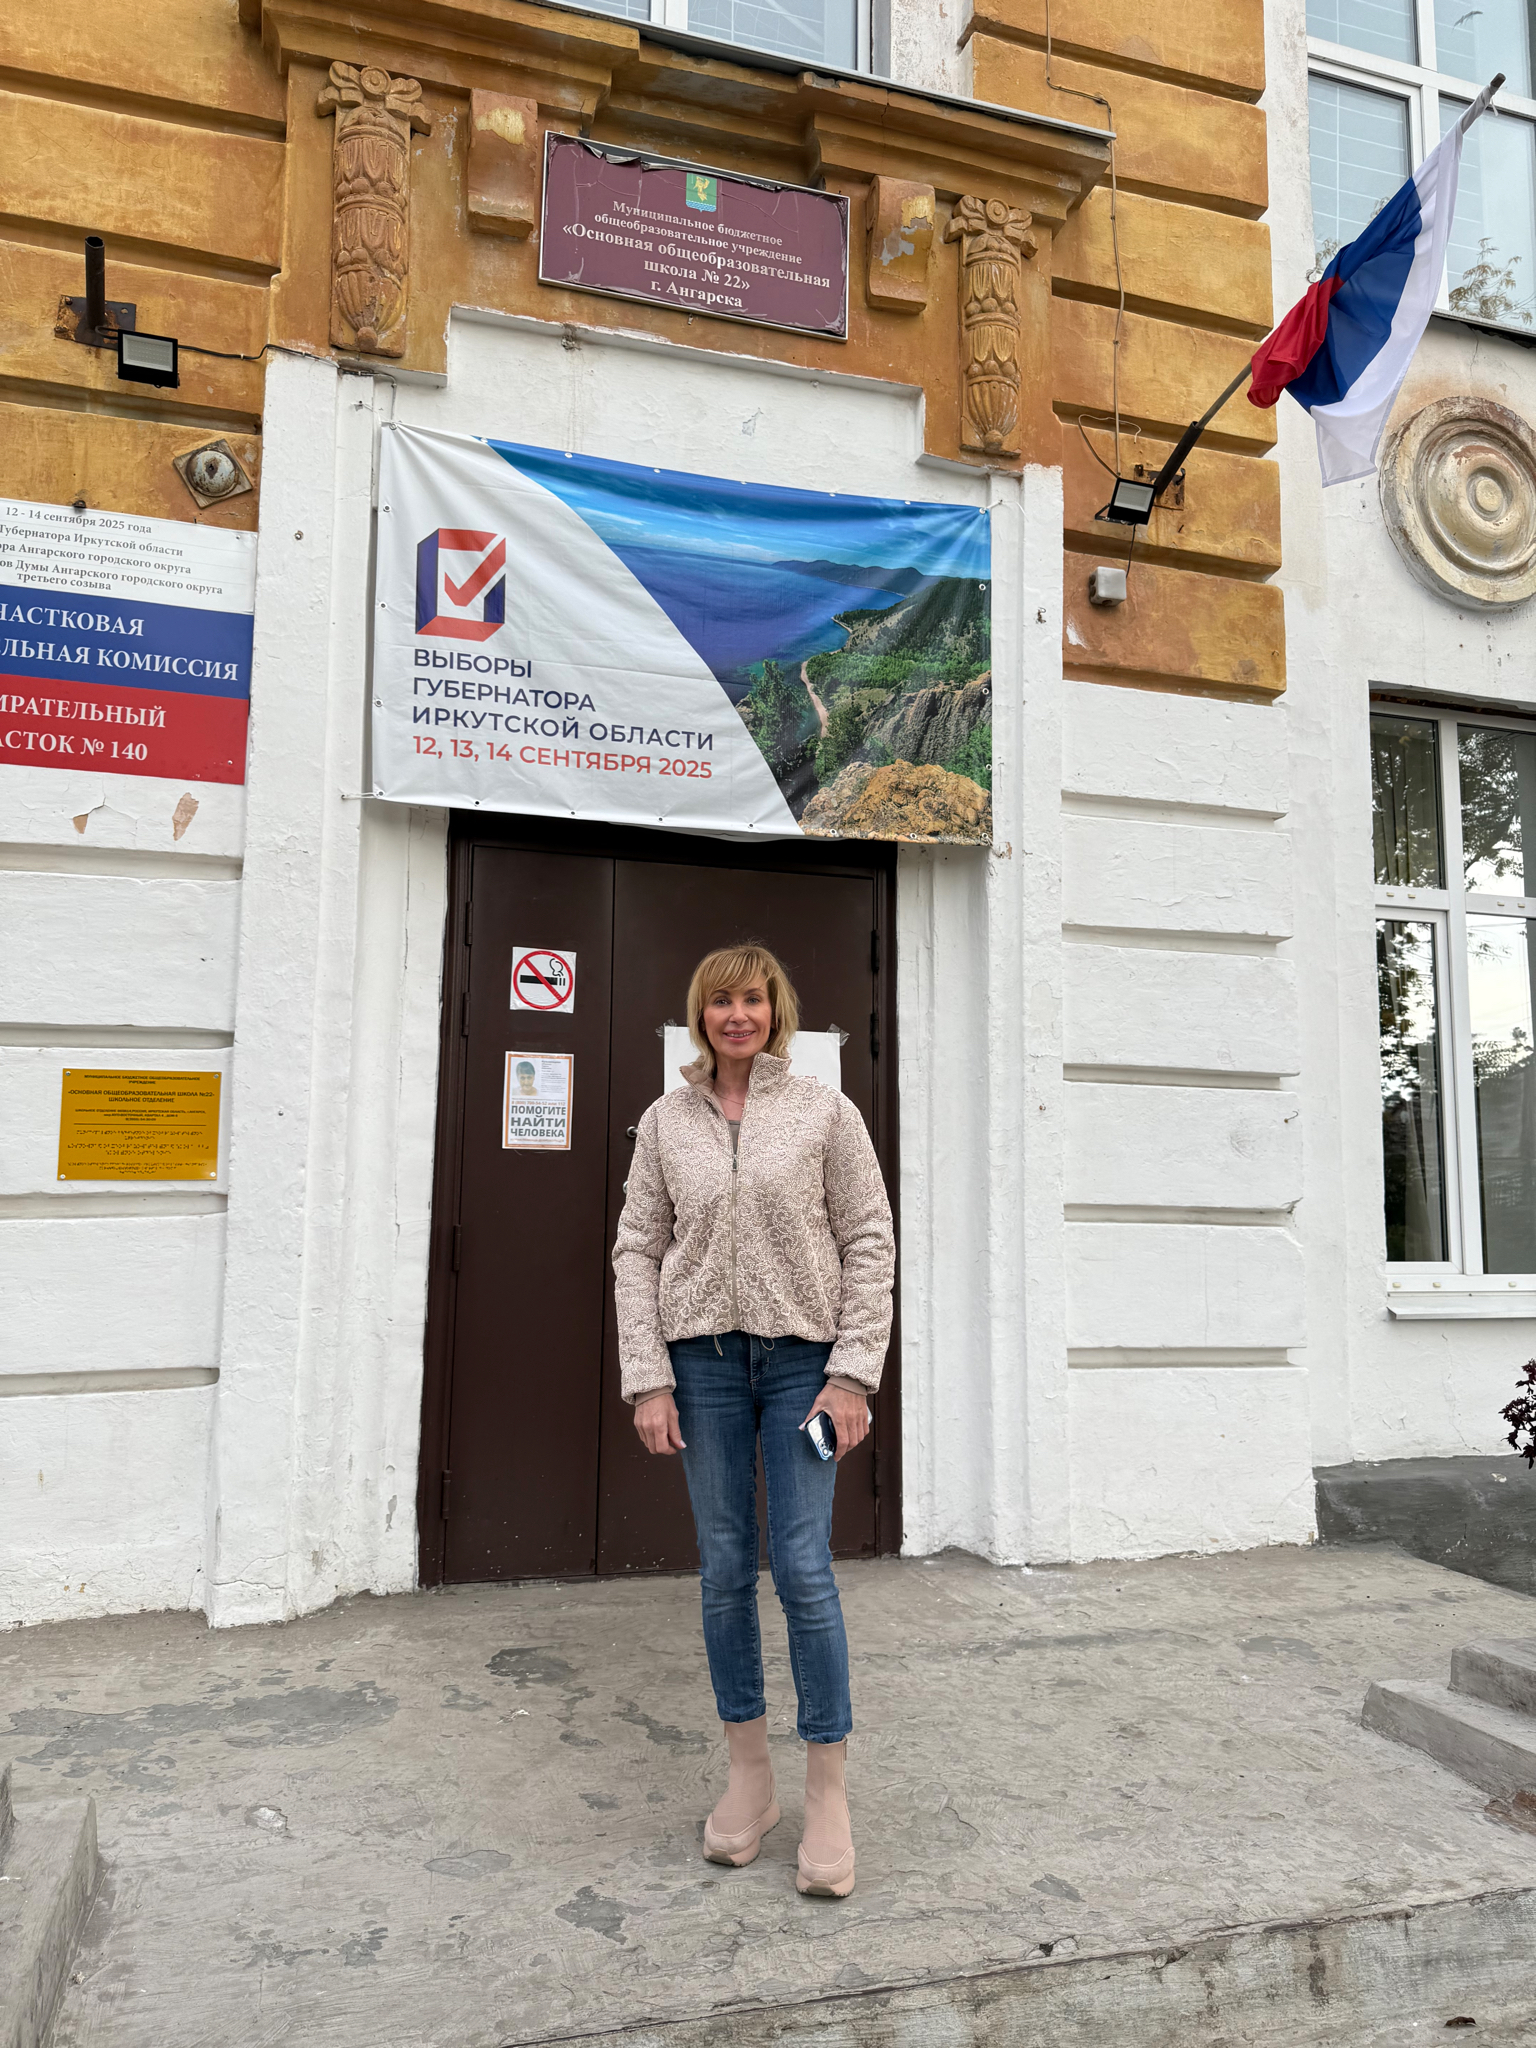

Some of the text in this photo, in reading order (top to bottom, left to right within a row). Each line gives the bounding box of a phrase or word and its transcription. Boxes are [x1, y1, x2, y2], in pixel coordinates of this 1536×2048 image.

[594, 213, 803, 264] общеобразовательное учреждение
[613, 201, 783, 246] Муниципальное бюджетное
[562, 223, 830, 288] «Основная общеобразовательная
[644, 260, 751, 290] школа № 22»
[651, 280, 743, 308] г. Ангарска
[6, 507, 18, 517] 12
[29, 510, 41, 519] 14
[43, 512, 96, 528] сентября
[99, 518, 125, 530] 2025
[128, 524, 152, 534] года
[0, 524, 183, 557] Губернатора Иркутской области
[18, 544, 85, 561] Ангарского
[88, 551, 151, 568] городского
[153, 562, 191, 575] округа
[15, 560, 49, 573] Думы
[52, 563, 118, 581] Ангарского
[121, 573, 184, 590] городского
[186, 582, 223, 596] округа
[16, 572, 111, 591] третьего созыва
[96, 648, 239, 681] КОМИССИЯ
[414, 648, 532, 679] ВЫБОРЫ
[413, 677, 596, 712] ГУБЕРНАТОРА
[412, 705, 714, 751] ИРКУТСКОЙ ОБЛАСТИ
[0, 730, 148, 761] СТОК № 140
[412, 735, 713, 779] 12, 13, 14 СЕНТЯБРЯ 2025
[511, 1105, 566, 1115] ПОМОГИТЕ
[511, 1115, 565, 1127] НАЙТИ
[510, 1128, 565, 1138] ЧЕЛОВЕКА
